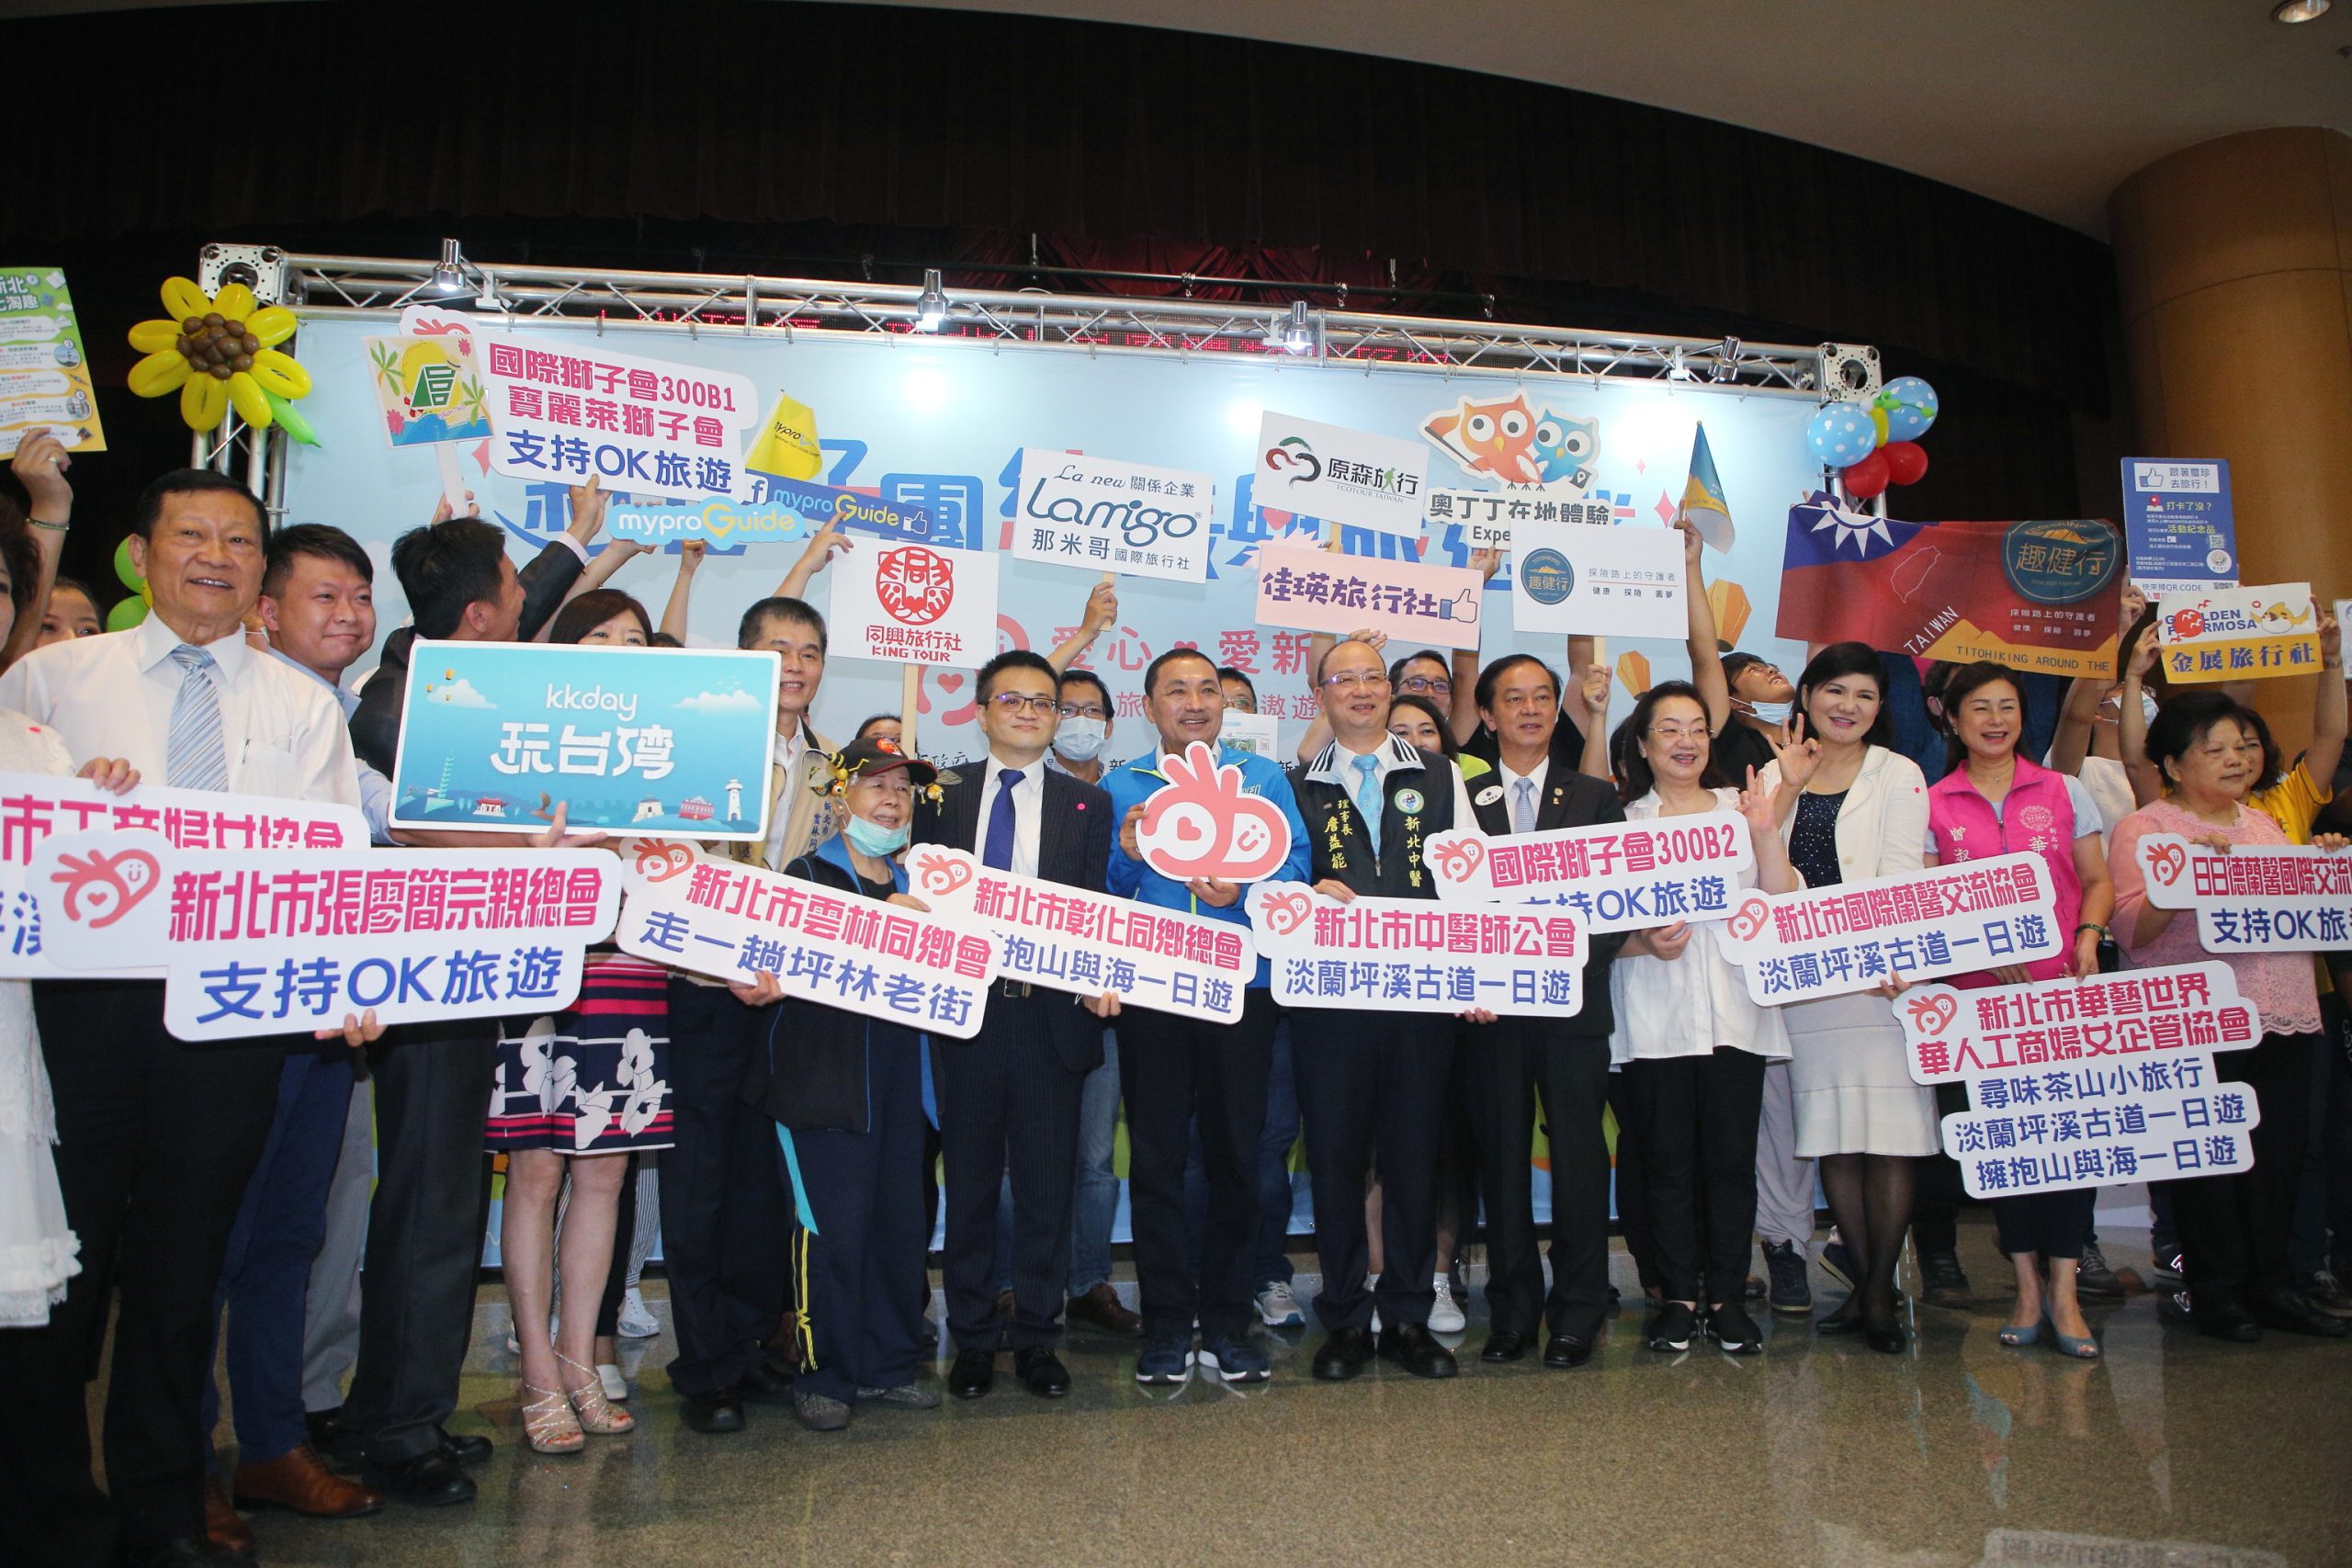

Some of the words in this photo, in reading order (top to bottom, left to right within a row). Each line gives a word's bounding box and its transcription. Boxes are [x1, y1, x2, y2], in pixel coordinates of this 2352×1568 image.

[490, 344, 736, 412] 國際獅子會300B1
[509, 386, 724, 447] 寶麗萊獅子會
[506, 430, 732, 494] 支持OK旅遊
[1054, 464, 1084, 482] La
[1091, 475, 1125, 489] new
[1130, 475, 1195, 498] 關係企業
[1328, 458, 1419, 495] 原森旅行
[1337, 484, 1373, 498] ECOTOUR
[1375, 491, 1404, 504] TAIWAN
[1430, 493, 1610, 526] 奧丁丁在地體驗
[618, 503, 795, 539] myproGuide
[1032, 528, 1110, 560] 那米哥
[1114, 547, 1190, 570] 國際旅行社
[2016, 544, 2107, 576] 趣健行
[1262, 567, 1438, 619] 佳瑛旅行社
[1589, 568, 1676, 582] 探險路上的守護者
[865, 625, 963, 652] 同興旅行社
[872, 645, 909, 660] KING
[913, 649, 951, 662] TOUR
[1904, 605, 1960, 655] TAIWAN
[1956, 646, 2029, 664] TITOHIKING
[2035, 655, 2079, 670] AROUND
[2086, 660, 2109, 671] THE
[2171, 643, 2316, 672] 金展旅行社
[546, 683, 638, 722] kkday
[1337, 798, 1353, 836] 理事長
[1488, 824, 1737, 888] 國際獅子會300B2
[2192, 856, 2352, 896] 日日德蘭馨國際交流
[169, 868, 602, 942] 新北市張廖簡宗親總會
[686, 863, 991, 980] 新北市雲林同鄉會
[974, 877, 1242, 971] 新北市彰化同鄉總會
[1772, 863, 2041, 944] 新北市國際蘭馨交流協會
[2211, 907, 2352, 943] 支持OK旅
[1314, 906, 1577, 957] 新北市中醫師公會
[1758, 913, 2051, 995] 淡蘭坪溪古道一日遊
[196, 946, 561, 1024] 支持OK旅遊
[639, 911, 974, 1026] 走一趟坪林老街
[990, 930, 1234, 1014] 抱山與海一日遊
[1285, 958, 1571, 1006] 淡蘭坪溪古道一日遊
[1976, 973, 2210, 1032] 新北市華藝世界
[1917, 1008, 2253, 1076] 華人工商婦女企管協會
[1979, 1057, 2204, 1110] 尋味茶山小旅行
[1955, 1094, 2246, 1154] 淡蘭坪溪古道一日遊
[1976, 1135, 2237, 1191] 擁抱山與海一日遊
